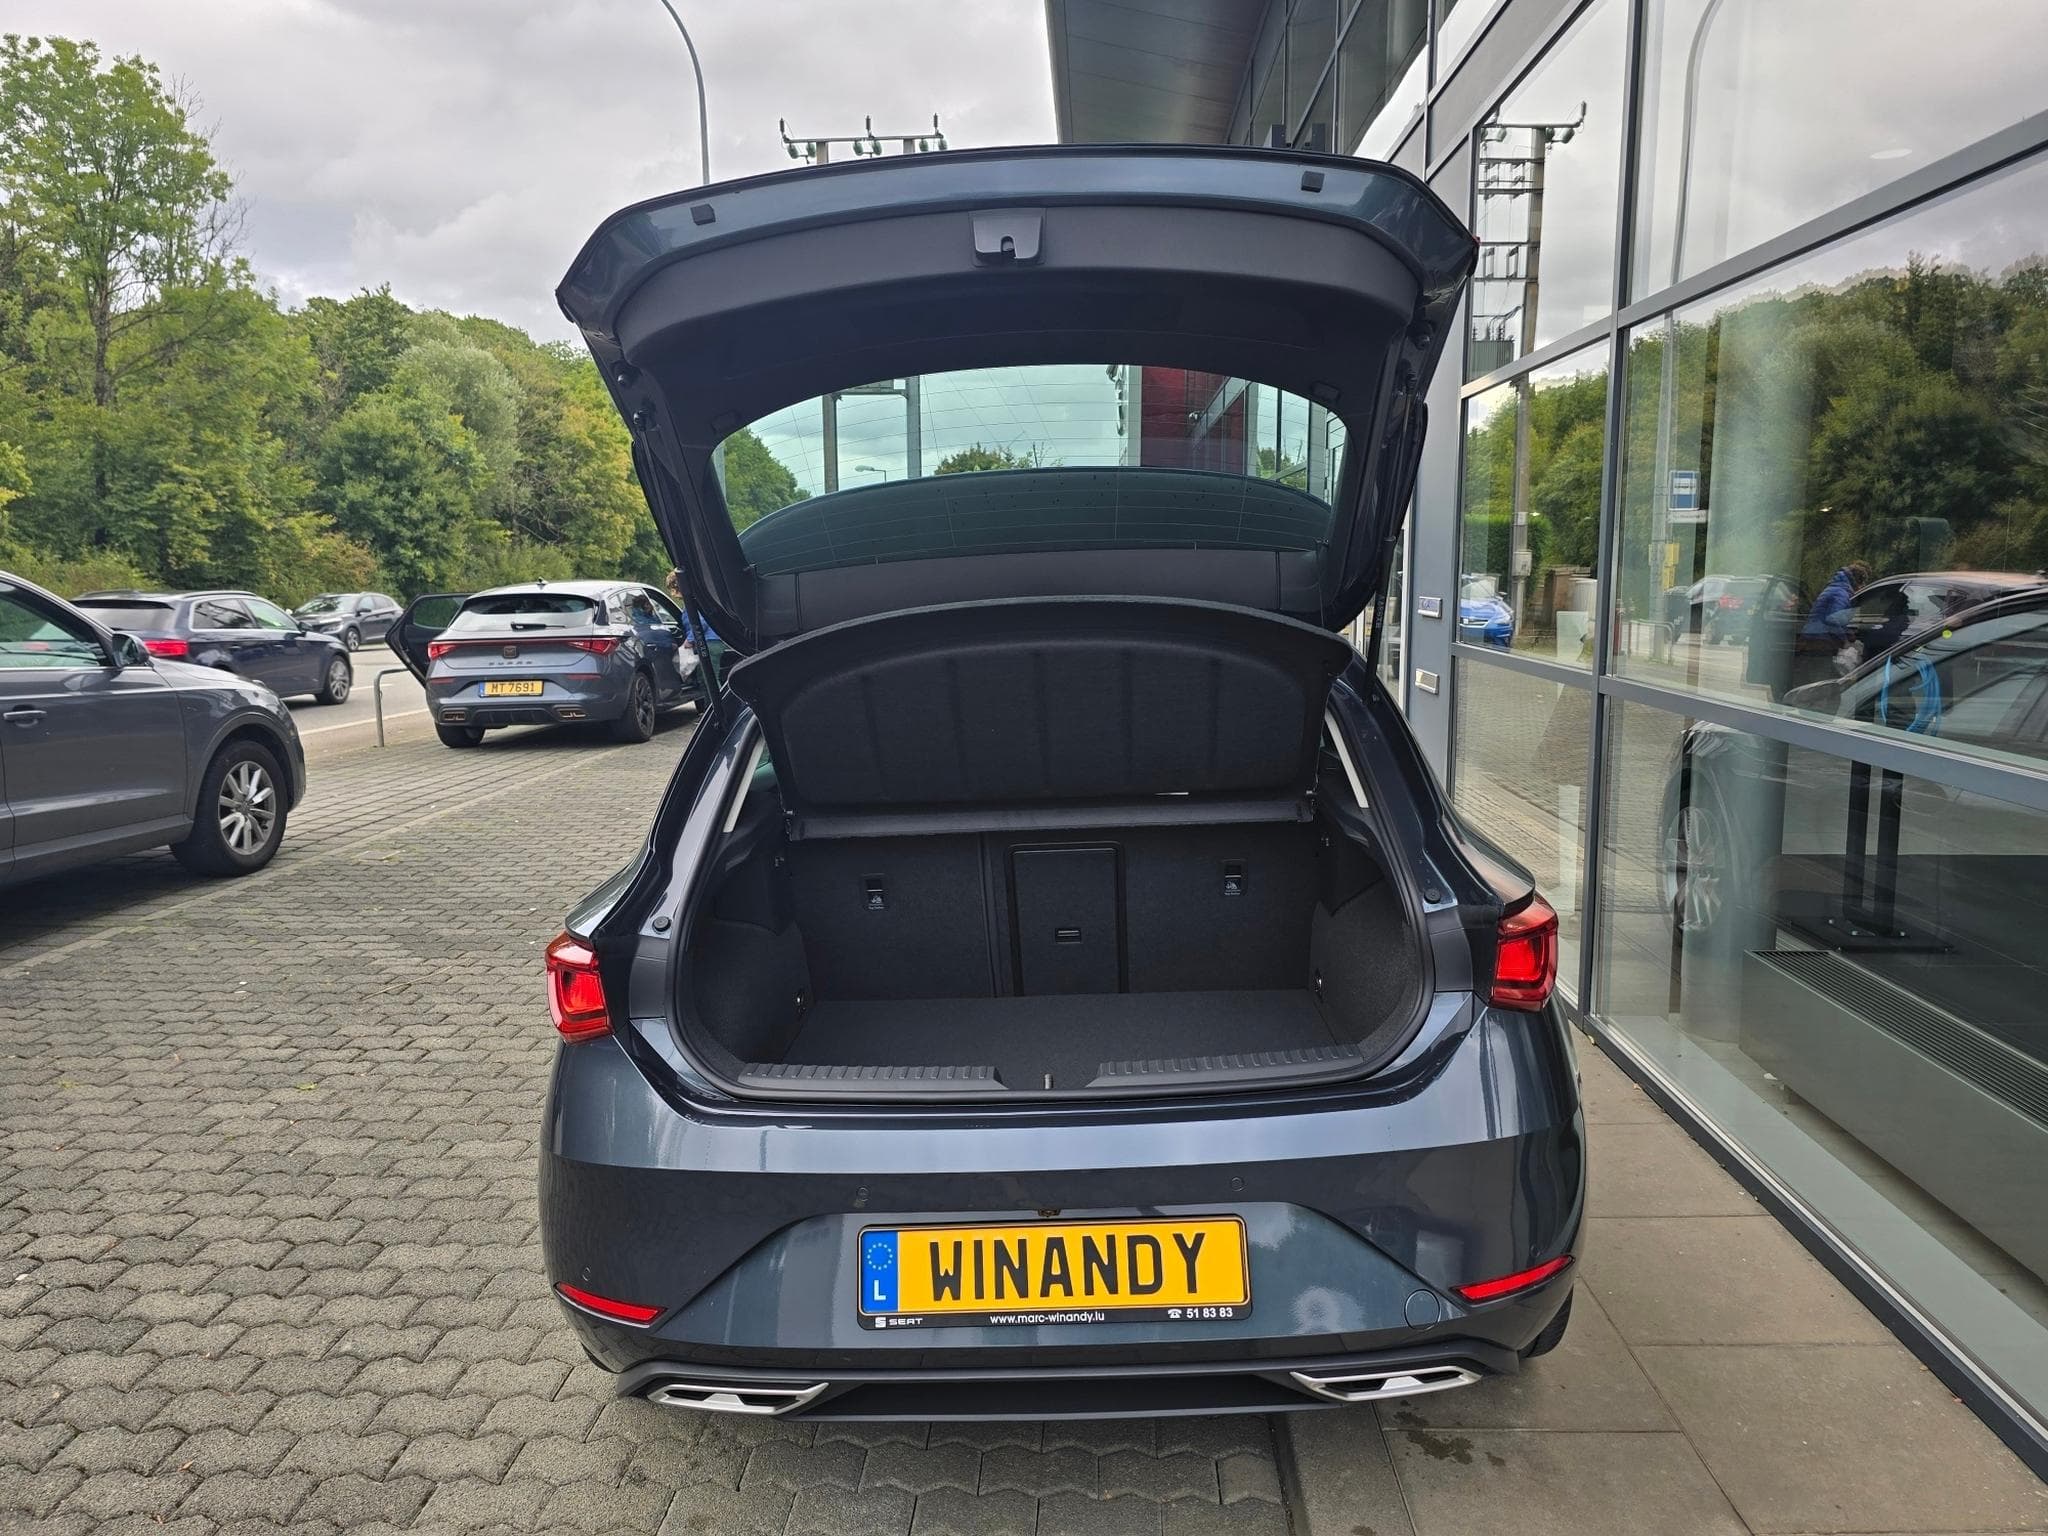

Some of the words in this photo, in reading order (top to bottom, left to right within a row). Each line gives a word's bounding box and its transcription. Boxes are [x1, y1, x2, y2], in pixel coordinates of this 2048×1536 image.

[509, 682, 535, 692] 7691
[929, 1231, 1206, 1301] WINANDY
[873, 1279, 886, 1301] L
[989, 1311, 1105, 1324] www.marc-winandy.lu
[1186, 1308, 1199, 1318] 51
[1202, 1307, 1217, 1318] 83
[1219, 1307, 1233, 1318] 83
[888, 1317, 923, 1326] SEAT
